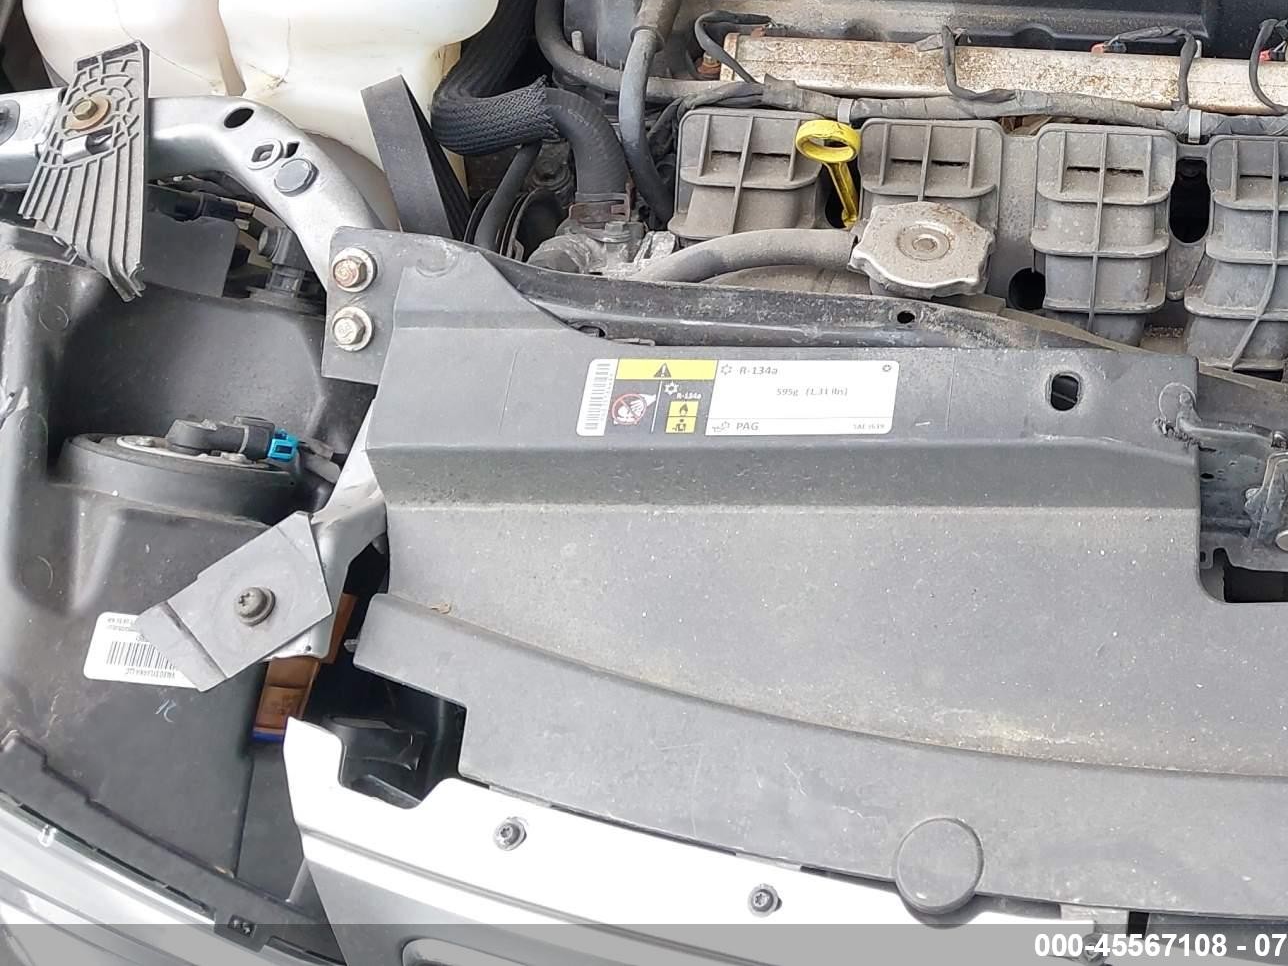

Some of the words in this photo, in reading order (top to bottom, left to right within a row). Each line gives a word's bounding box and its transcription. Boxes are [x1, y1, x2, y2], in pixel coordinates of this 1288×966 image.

[740, 365, 778, 375] R-134a
[776, 388, 799, 397] 595g
[736, 421, 759, 431] PAG
